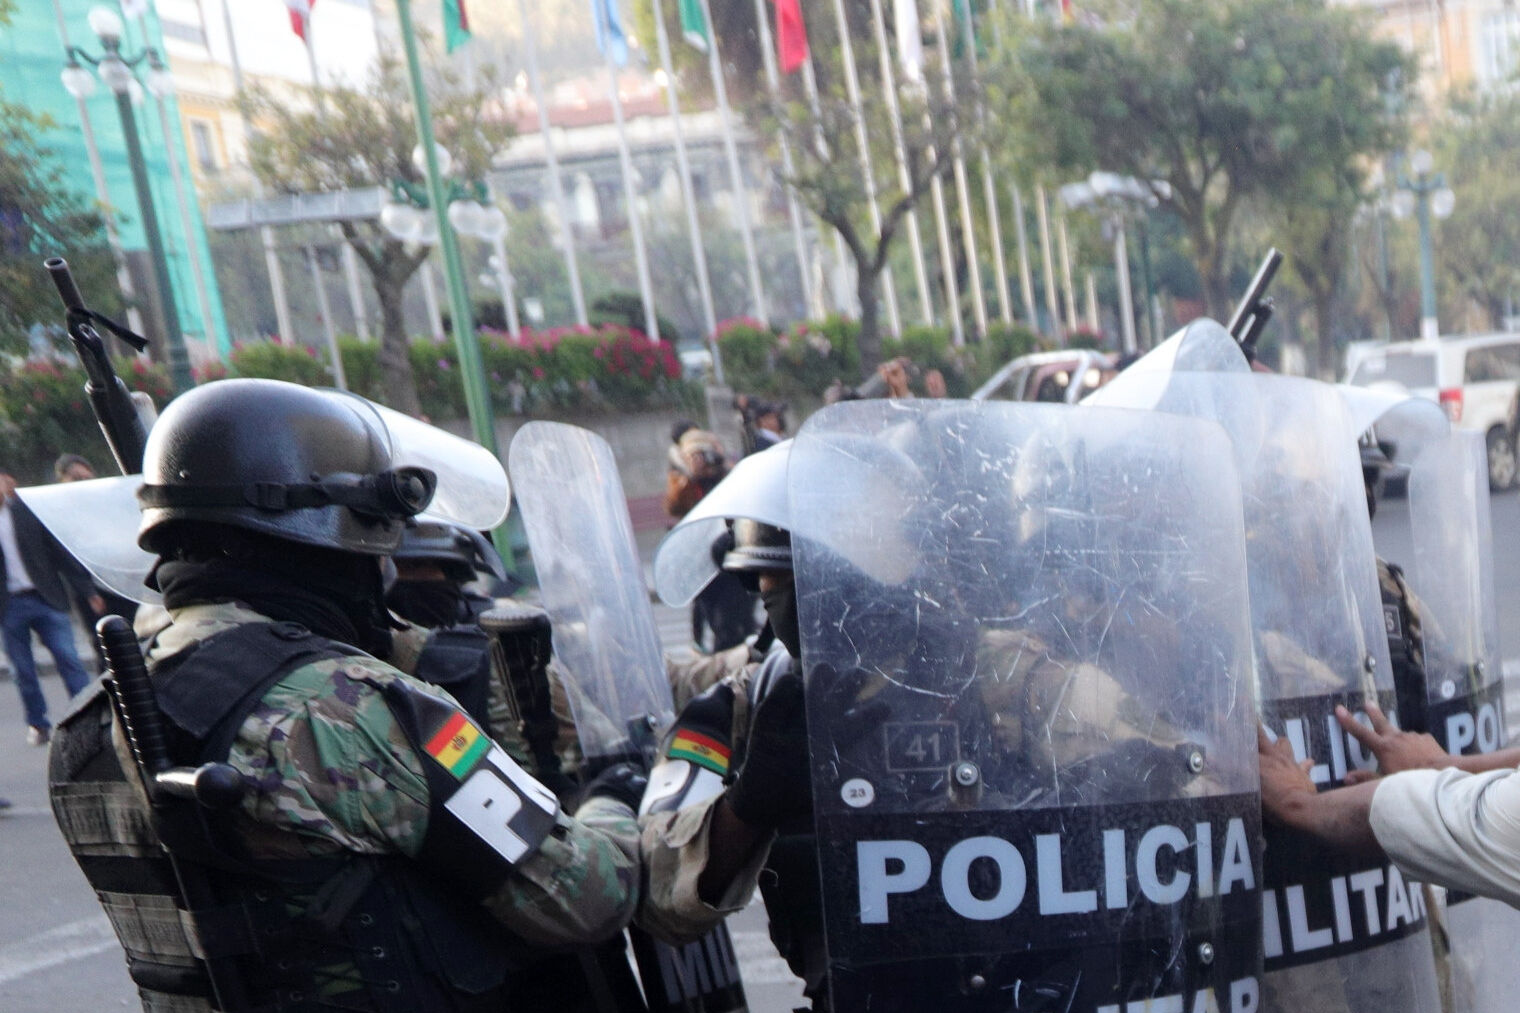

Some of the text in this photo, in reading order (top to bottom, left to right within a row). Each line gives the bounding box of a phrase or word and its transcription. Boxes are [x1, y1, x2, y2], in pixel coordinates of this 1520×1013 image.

[904, 732, 940, 761] 41
[856, 817, 1256, 924] POLICIA
[1262, 865, 1428, 958] ILITAR
